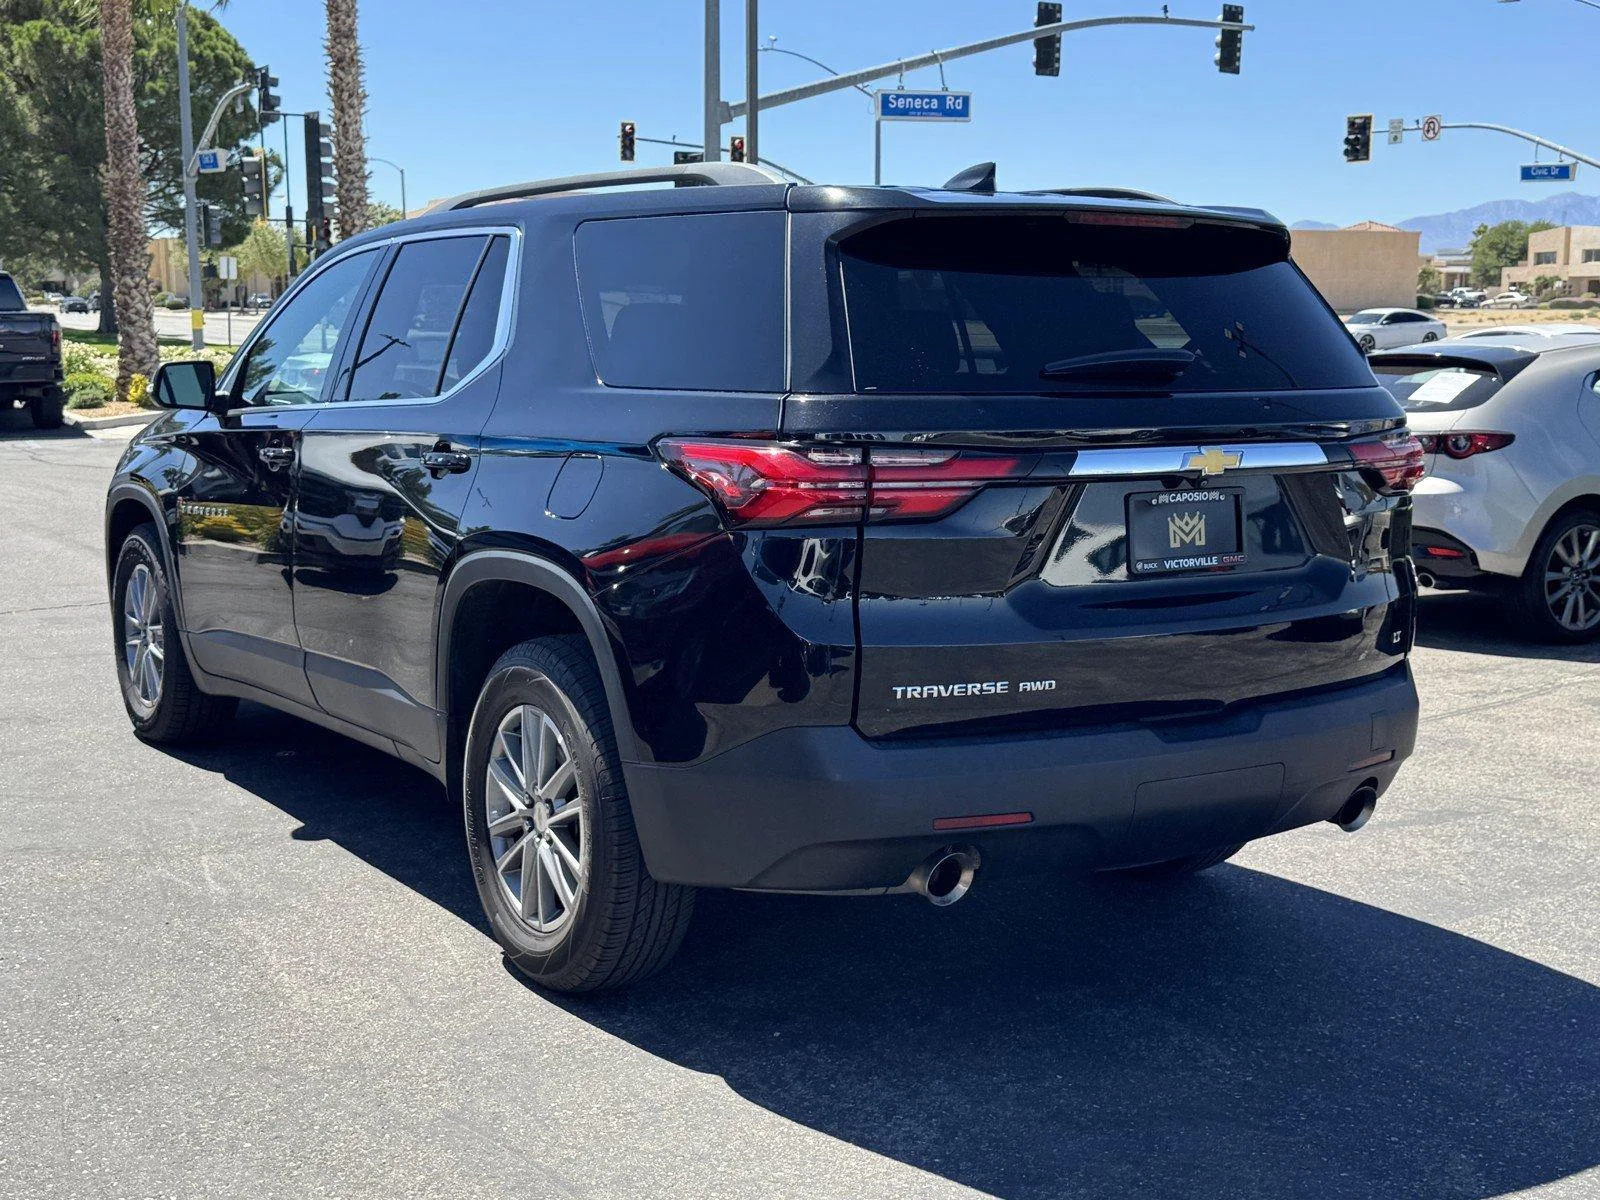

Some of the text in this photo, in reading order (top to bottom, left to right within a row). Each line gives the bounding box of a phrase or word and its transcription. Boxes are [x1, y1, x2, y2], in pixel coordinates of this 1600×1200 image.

[888, 94, 963, 109] Seneca Rd
[1531, 165, 1560, 176] Civic Dr
[1169, 491, 1209, 503] CAPOSIO
[1143, 555, 1245, 570] BUICK VICTORVILLE GMC
[1392, 630, 1402, 643] LT
[892, 679, 1056, 699] TRAVERSE AWD
